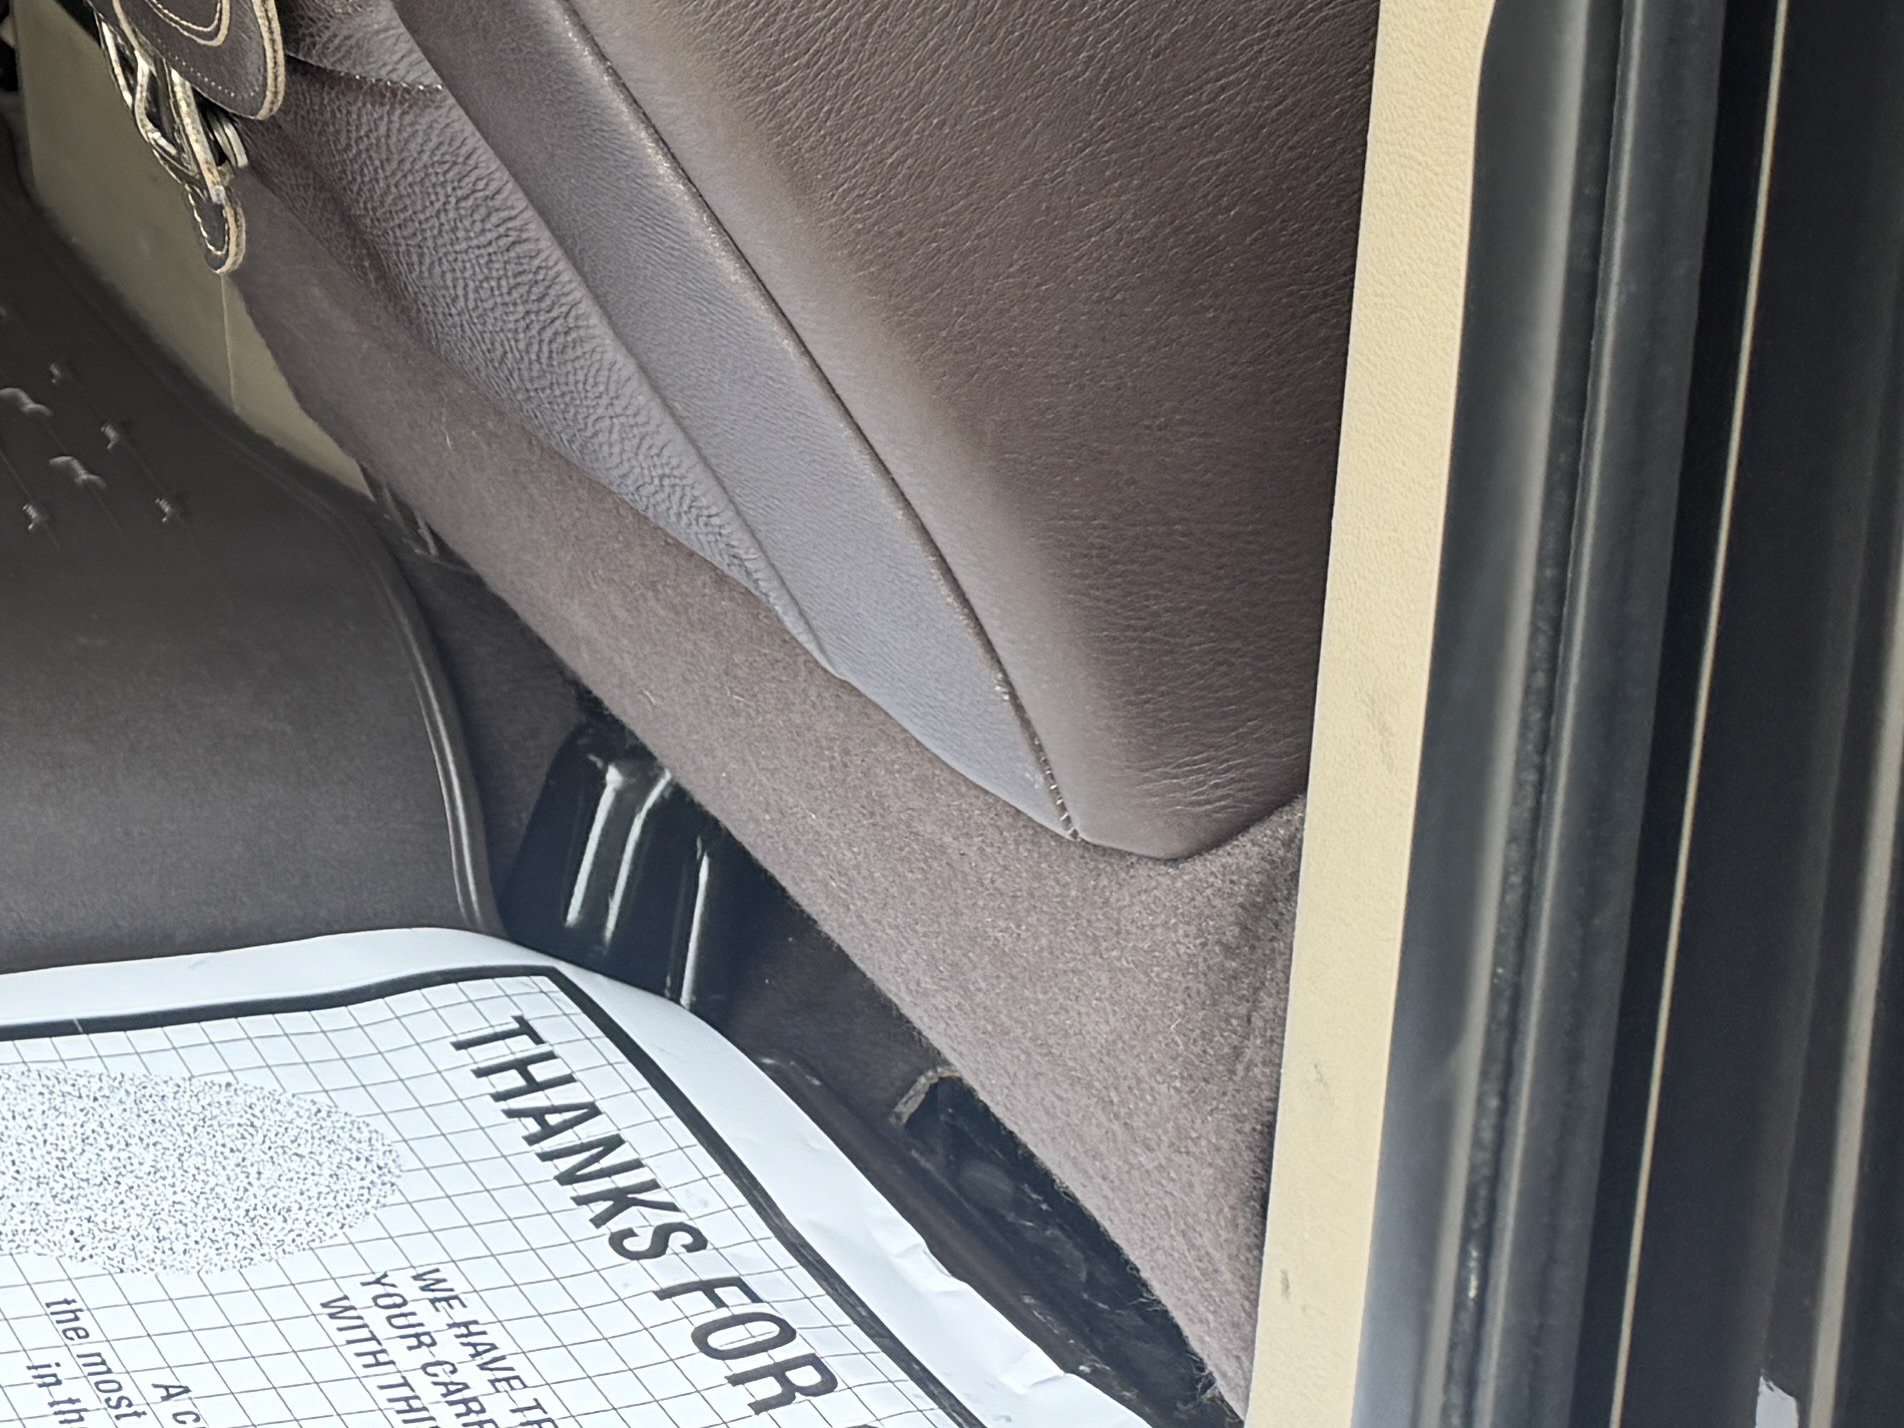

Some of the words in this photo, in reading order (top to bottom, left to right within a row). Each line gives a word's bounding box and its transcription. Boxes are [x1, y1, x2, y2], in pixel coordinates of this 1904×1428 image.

[450, 1015, 709, 1262] THANKS
[653, 1275, 838, 1415] FOR
[44, 1297, 90, 1342] the
[76, 1351, 148, 1422] most
[318, 1294, 395, 1370] WITH
[376, 1375, 441, 1428] THI
[360, 1270, 438, 1352] YOUR
[410, 1267, 467, 1313] WE
[446, 1318, 527, 1393] HAVE
[26, 1361, 63, 1389] in
[47, 1397, 90, 1428] th
[151, 1382, 192, 1402] A
